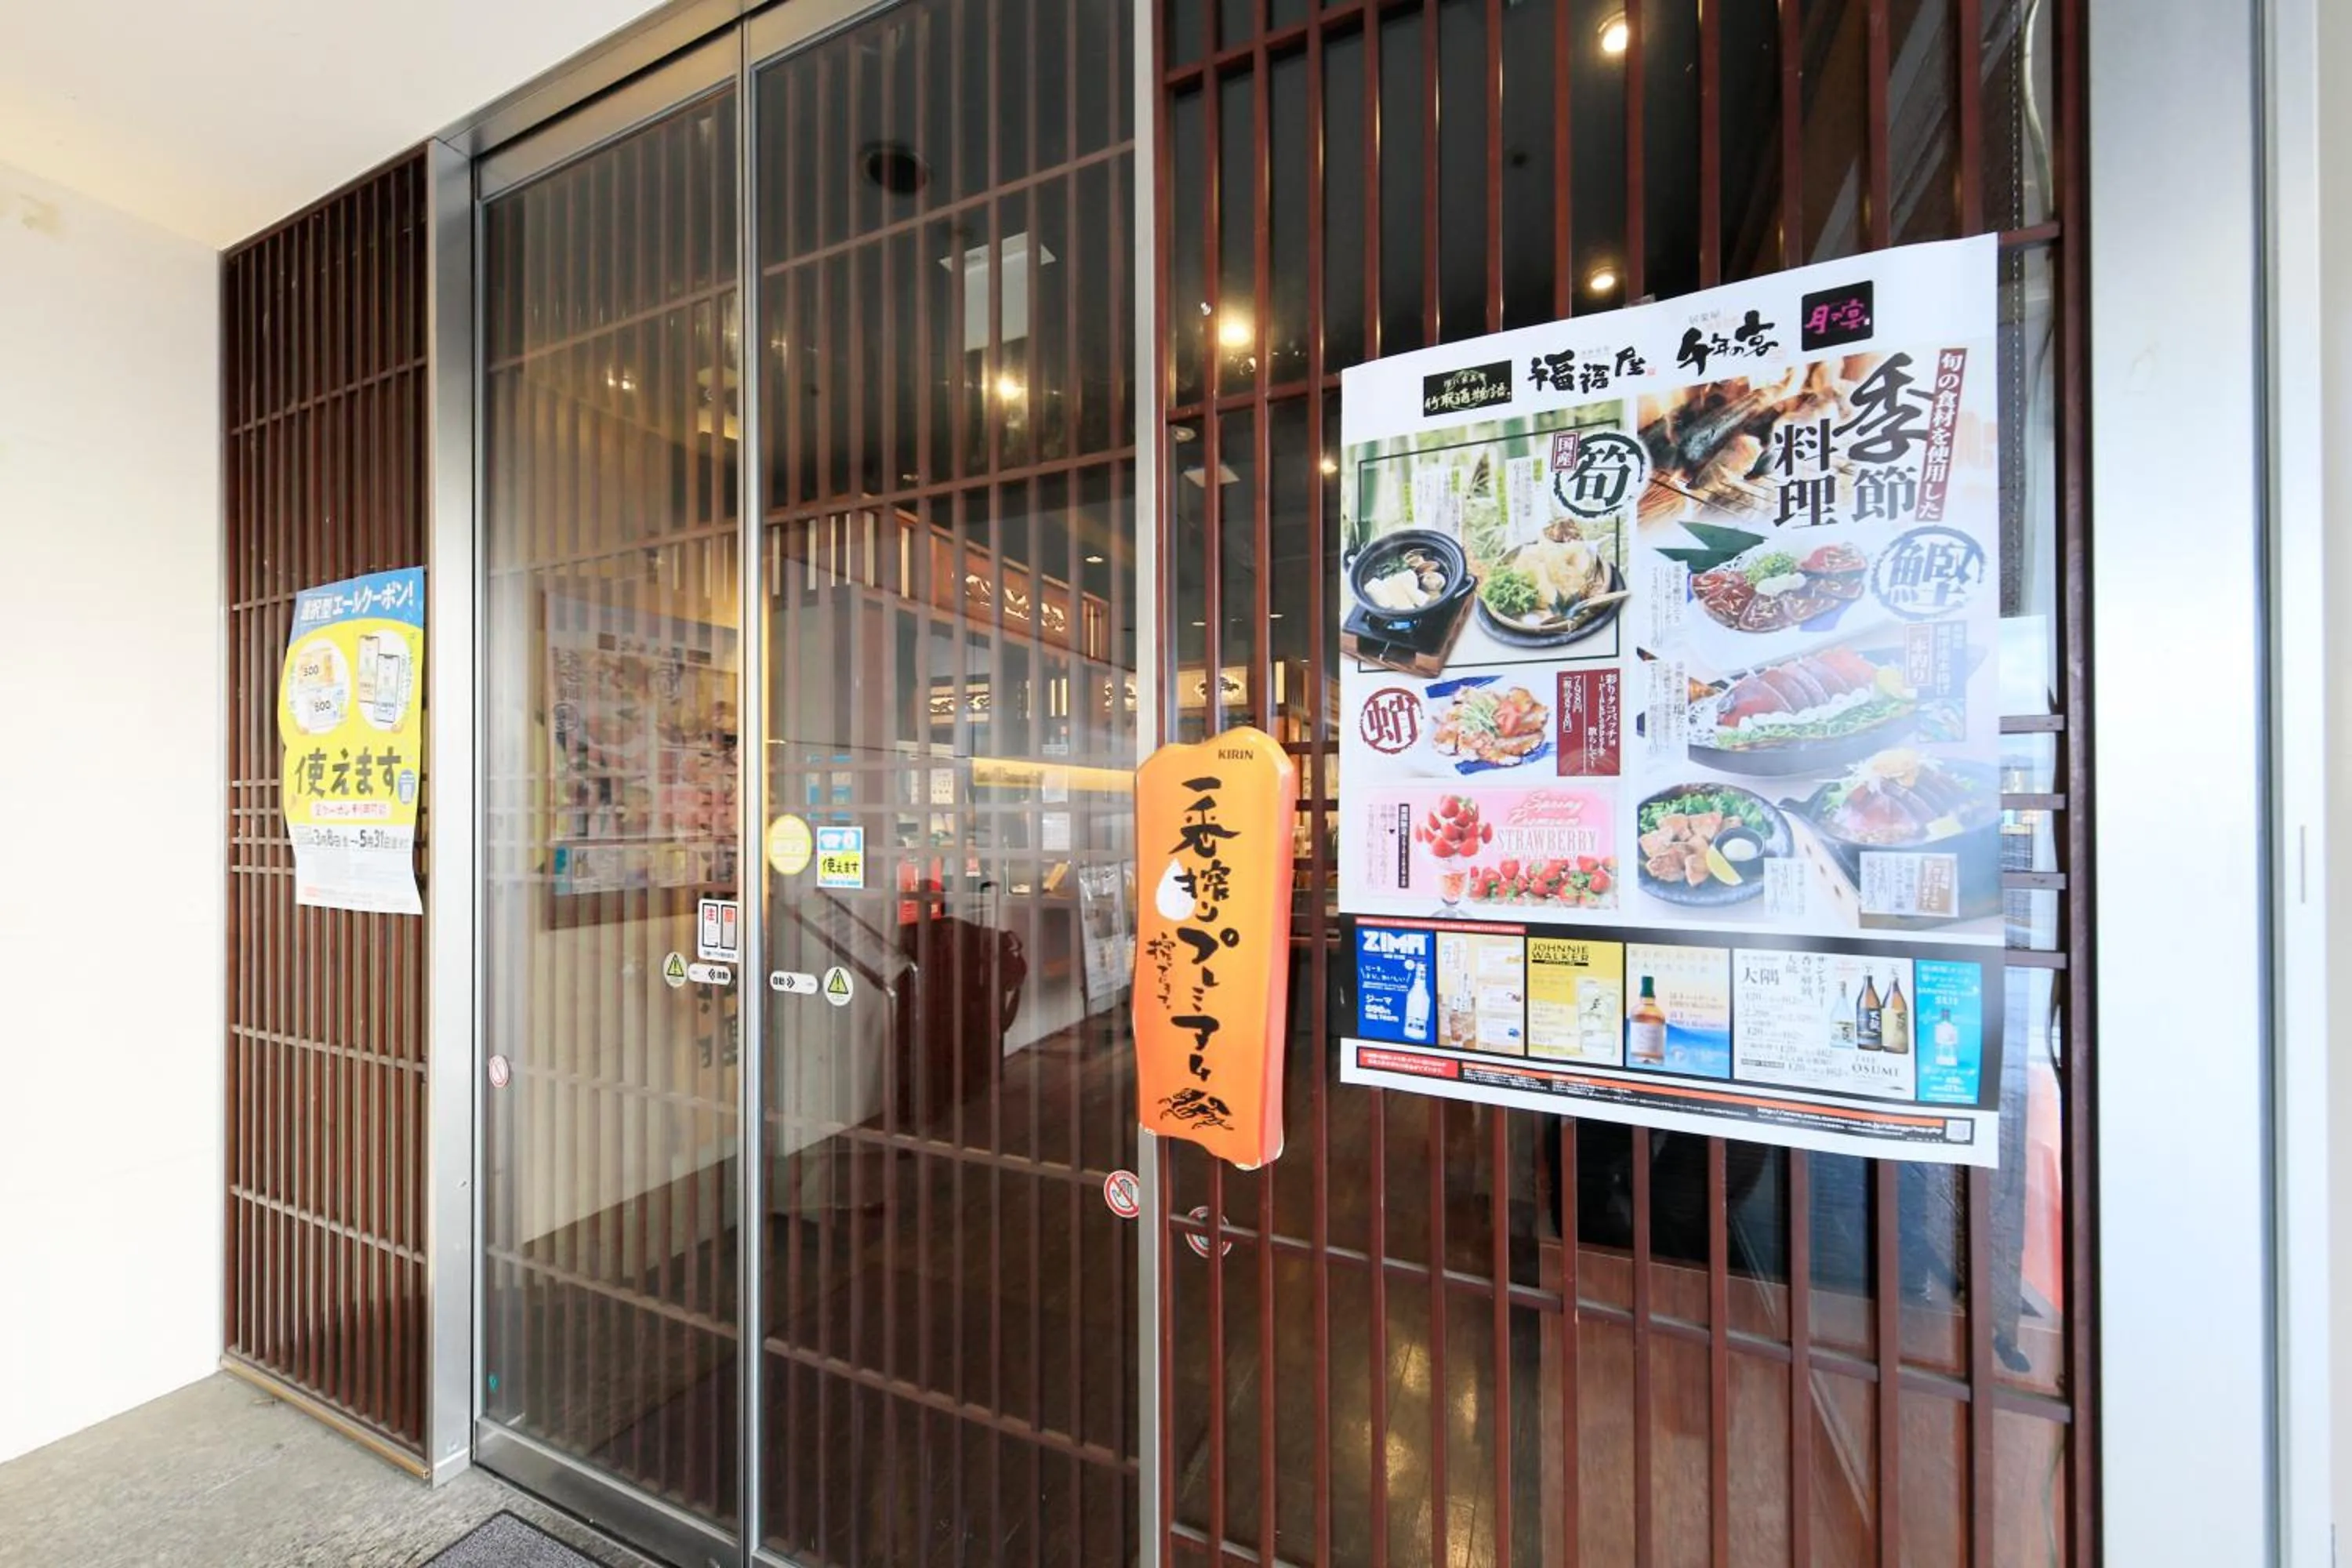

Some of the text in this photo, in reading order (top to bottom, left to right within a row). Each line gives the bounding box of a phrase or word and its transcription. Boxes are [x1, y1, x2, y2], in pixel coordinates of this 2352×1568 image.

[1805, 298, 1864, 335] 月の宴
[1676, 310, 1778, 376] 千年の宴
[1528, 347, 1646, 394] 福福屋
[1555, 435, 1575, 467] 国産
[1918, 352, 1963, 519] 旬の食材を使用した
[1568, 444, 1632, 507] 筍
[1218, 750, 1254, 760] KIRIN
[295, 746, 402, 798] 使えます
[1497, 827, 1596, 852] STRAWBERRY
[822, 857, 859, 874] 使えます
[1168, 775, 1242, 1083] 一番搾りプレミアム
[1362, 930, 1427, 956] ZIMA
[1531, 942, 1589, 954] JOHNNIE
[1531, 951, 1589, 961] WALKER
[1851, 1062, 1899, 1077] OSUMI
